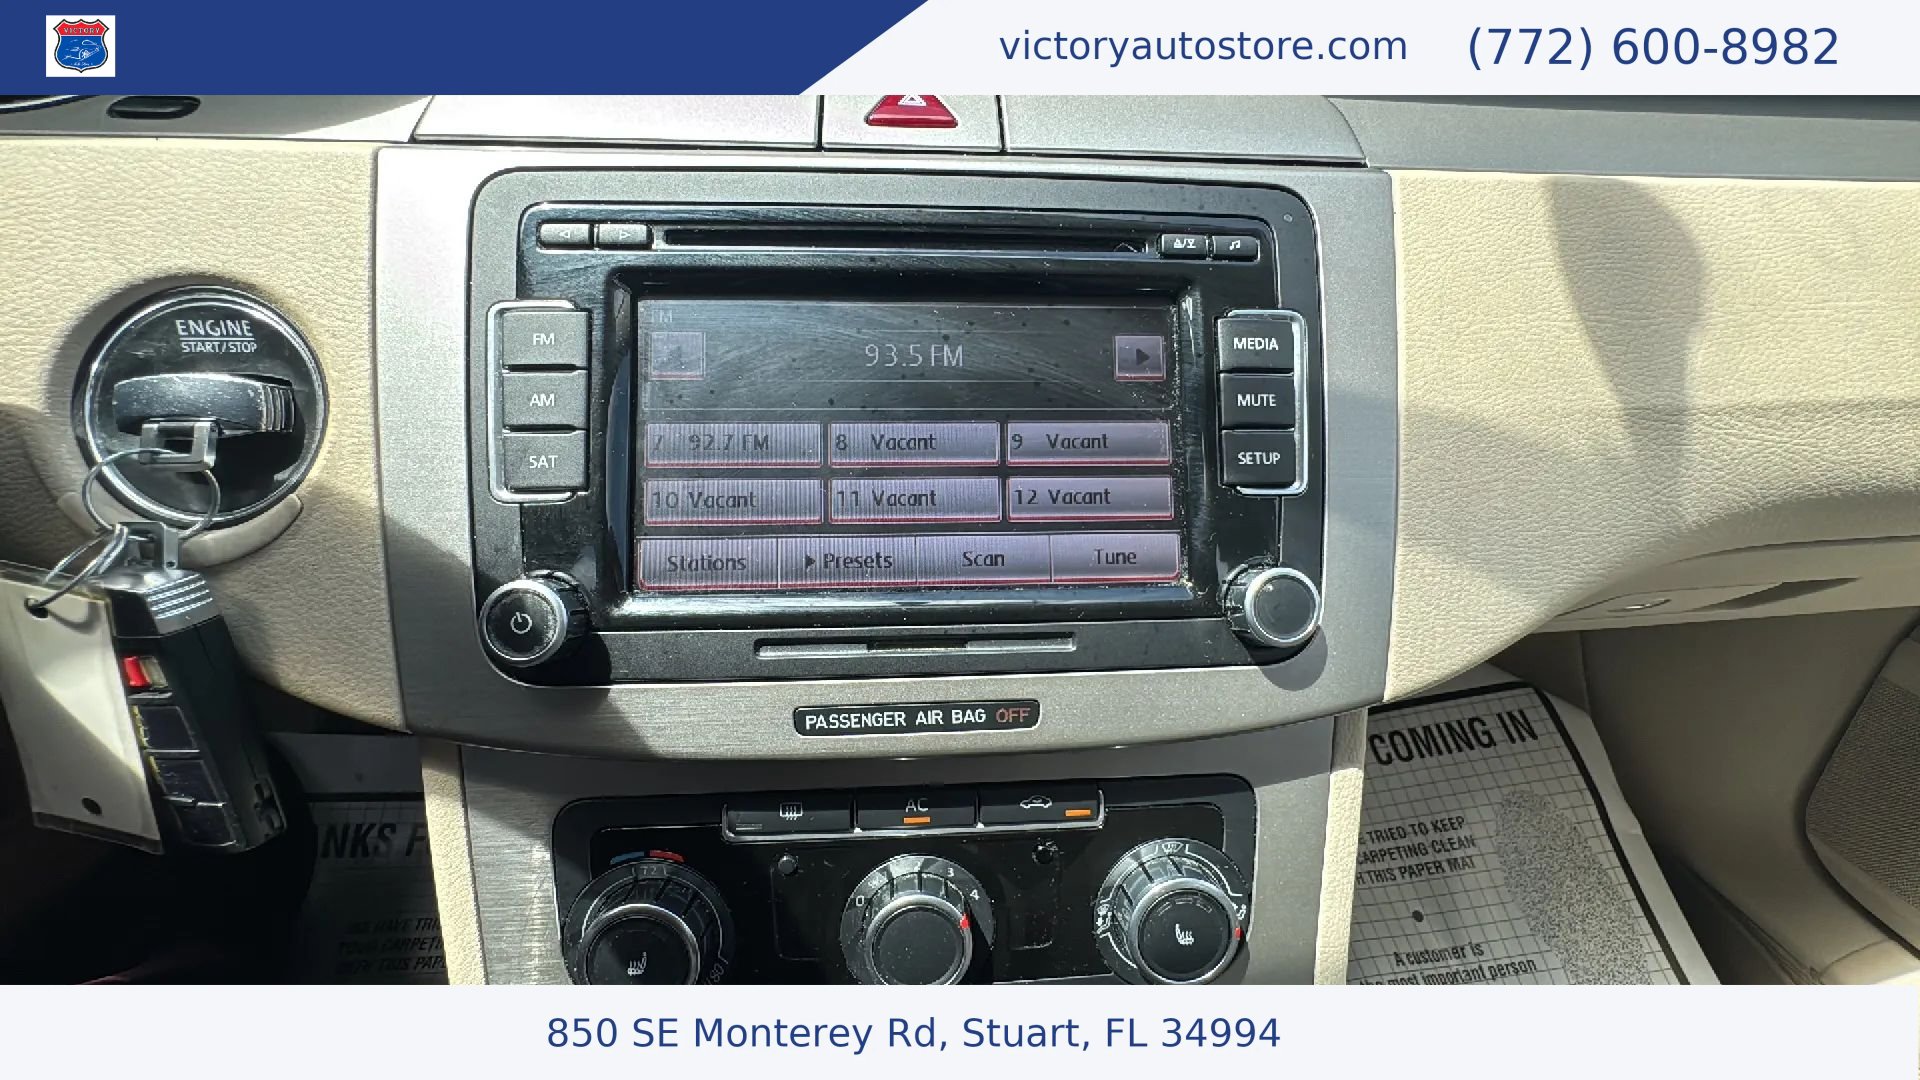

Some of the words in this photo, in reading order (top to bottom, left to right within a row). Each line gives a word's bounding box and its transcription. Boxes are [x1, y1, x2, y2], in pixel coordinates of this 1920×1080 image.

[176, 320, 254, 336] ENGINE
[533, 333, 555, 346] FM
[1233, 337, 1279, 350] MEDIA
[865, 344, 923, 367] 93.5
[931, 344, 963, 367] FM
[530, 393, 555, 407] AM
[1237, 394, 1277, 407] MUTE
[687, 434, 734, 451] 92.7
[742, 433, 769, 451] FM
[835, 434, 848, 451] 8
[871, 433, 937, 451] Vacant
[1011, 433, 1023, 450] 9
[1046, 433, 1109, 450] Vacant
[529, 455, 558, 468] SAT
[1237, 452, 1281, 465] SETUP
[653, 491, 679, 509] 10
[688, 490, 756, 509] Vacant
[837, 490, 859, 507] 11
[872, 489, 937, 507] Vacant
[1014, 489, 1038, 505] 12
[1048, 487, 1111, 505] Vacant
[667, 554, 747, 572] Stations
[823, 551, 894, 570] Presets
[962, 550, 1005, 567] Scan
[1095, 548, 1138, 565] Tune
[805, 711, 907, 730] PASSENGER
[915, 709, 945, 726] AIR
[951, 708, 987, 725] BAG
[995, 707, 1032, 723] OFF
[1369, 715, 1497, 767] COMING
[1495, 708, 1539, 745] IN
[905, 797, 929, 812] AC
[1365, 825, 1407, 845] TRIED
[1408, 821, 1429, 838] TO
[1430, 815, 1465, 834] KEEP
[1431, 835, 1477, 854] CLEAN
[639, 865, 658, 877] 72
[946, 867, 955, 878] 3
[1366, 867, 1397, 885] THIS
[1398, 860, 1446, 880] PAPER
[1446, 855, 1477, 873] MAT
[969, 889, 981, 901] 4
[1393, 951, 1406, 967] A
[1405, 947, 1469, 966] customer
[1467, 941, 1485, 957] is
[1487, 958, 1538, 981] person
